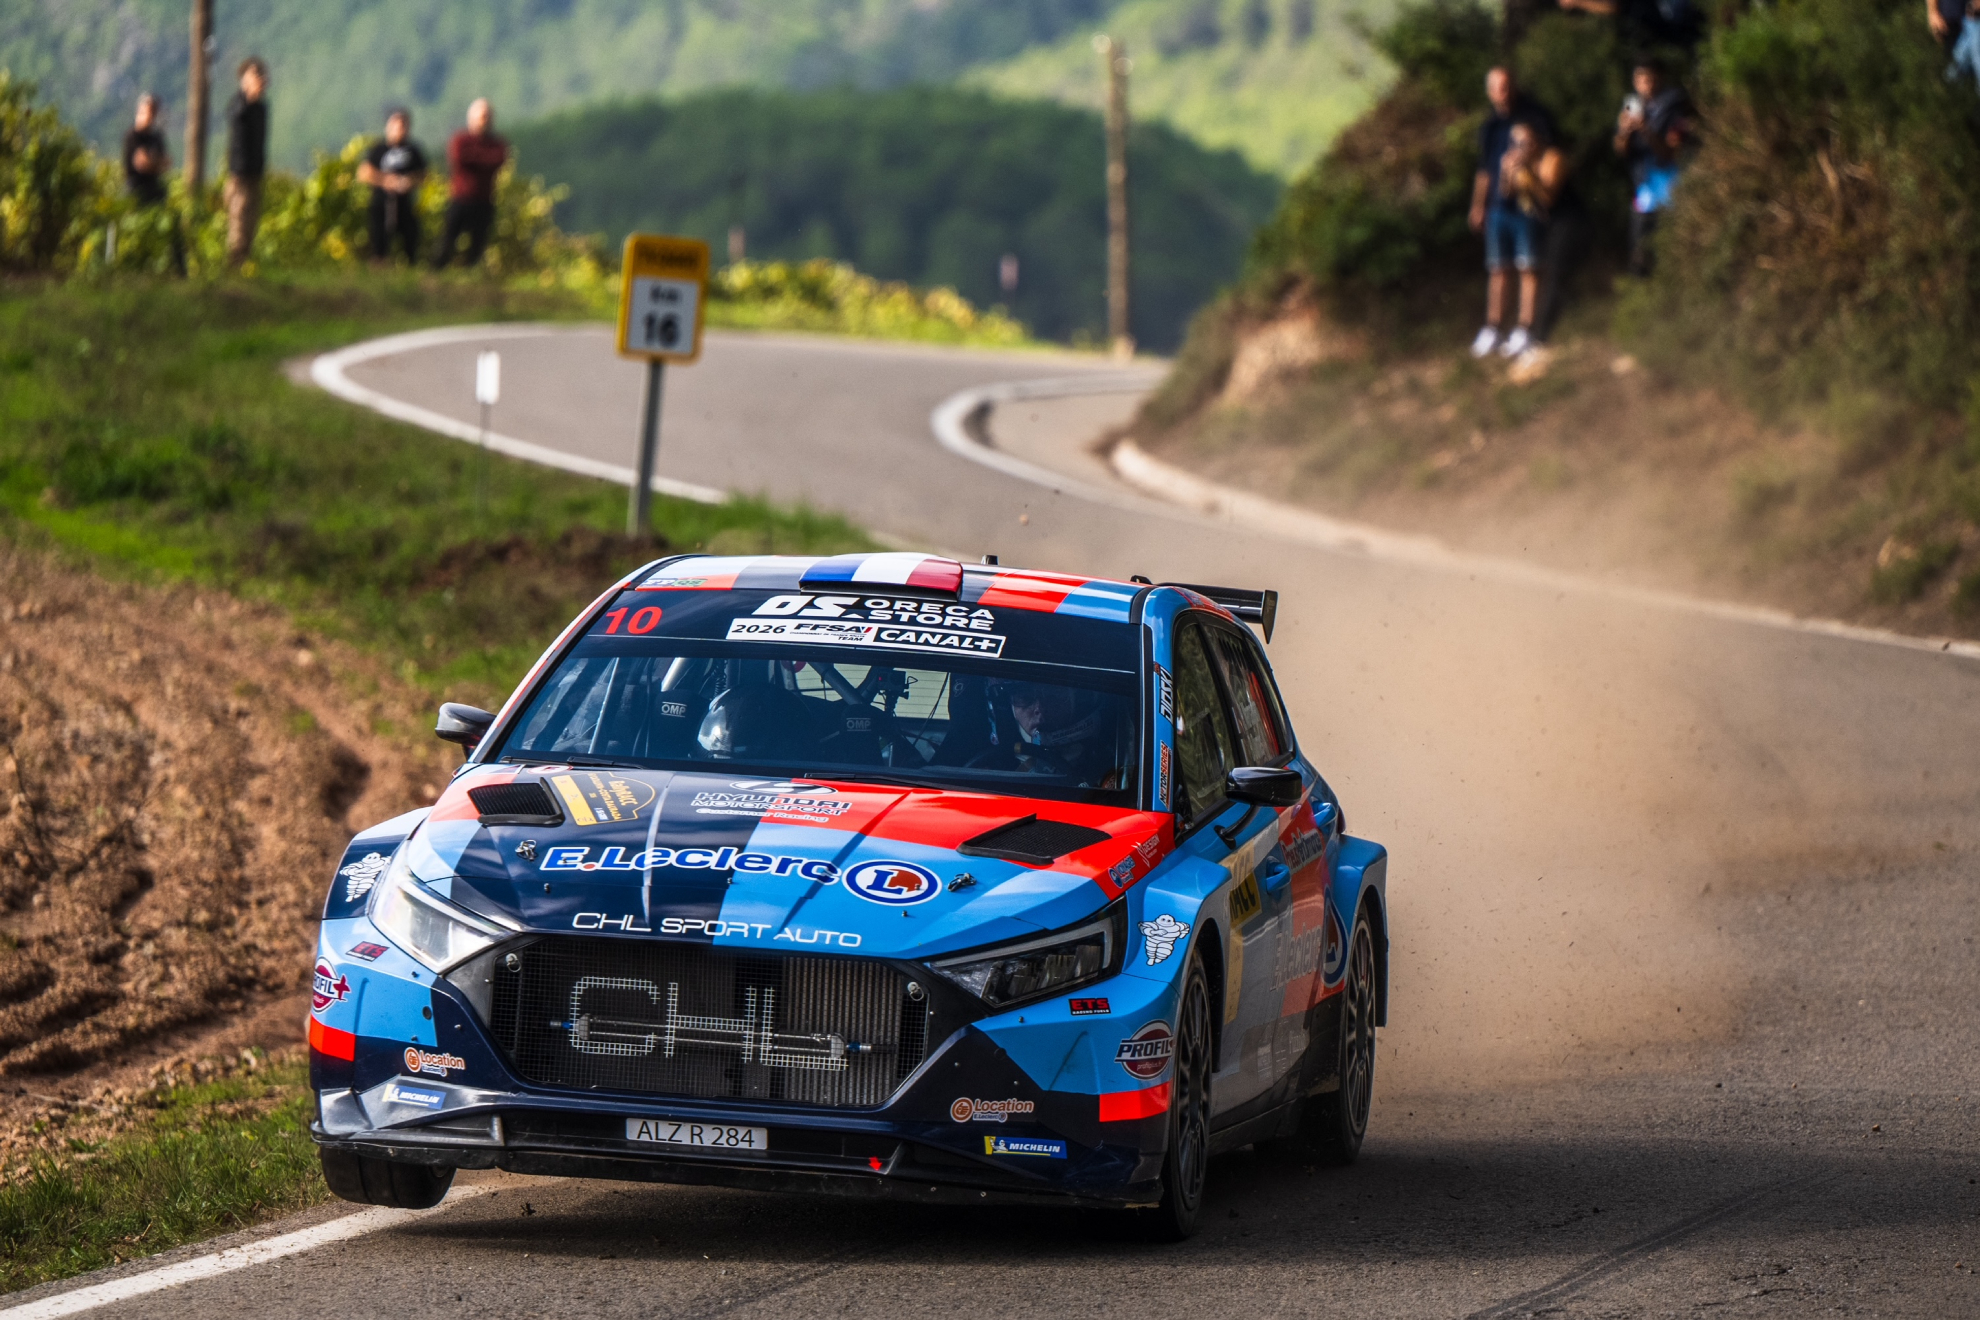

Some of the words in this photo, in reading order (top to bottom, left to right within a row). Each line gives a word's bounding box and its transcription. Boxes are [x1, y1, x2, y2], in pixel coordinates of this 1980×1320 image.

[864, 599, 995, 620] ORECA
[605, 606, 663, 634] 10
[868, 610, 992, 631] STORE
[731, 623, 786, 634] 2026
[793, 623, 866, 633] FFSA
[880, 630, 996, 650] CANAL+
[661, 703, 686, 716] OMP
[846, 719, 872, 730] OMP
[691, 800, 847, 815] MOTORSPORT
[695, 792, 852, 809] HYUNDAI
[696, 808, 773, 817] Customer
[774, 812, 829, 823] Racing
[540, 847, 842, 885] E.Leclerc
[572, 912, 652, 932] CHL
[661, 916, 772, 940] SPORT
[774, 926, 861, 947] AUTO
[354, 942, 388, 957] ETS
[1071, 999, 1109, 1010] ETS
[1116, 1040, 1171, 1057] PROFIL
[420, 1050, 465, 1070] Location
[399, 1092, 440, 1103] MICHELIN
[974, 1098, 1034, 1113] Location
[636, 1120, 683, 1143] ALZ
[690, 1124, 704, 1144] R
[711, 1127, 755, 1147] 284
[1009, 1143, 1060, 1153] MICHELIN
